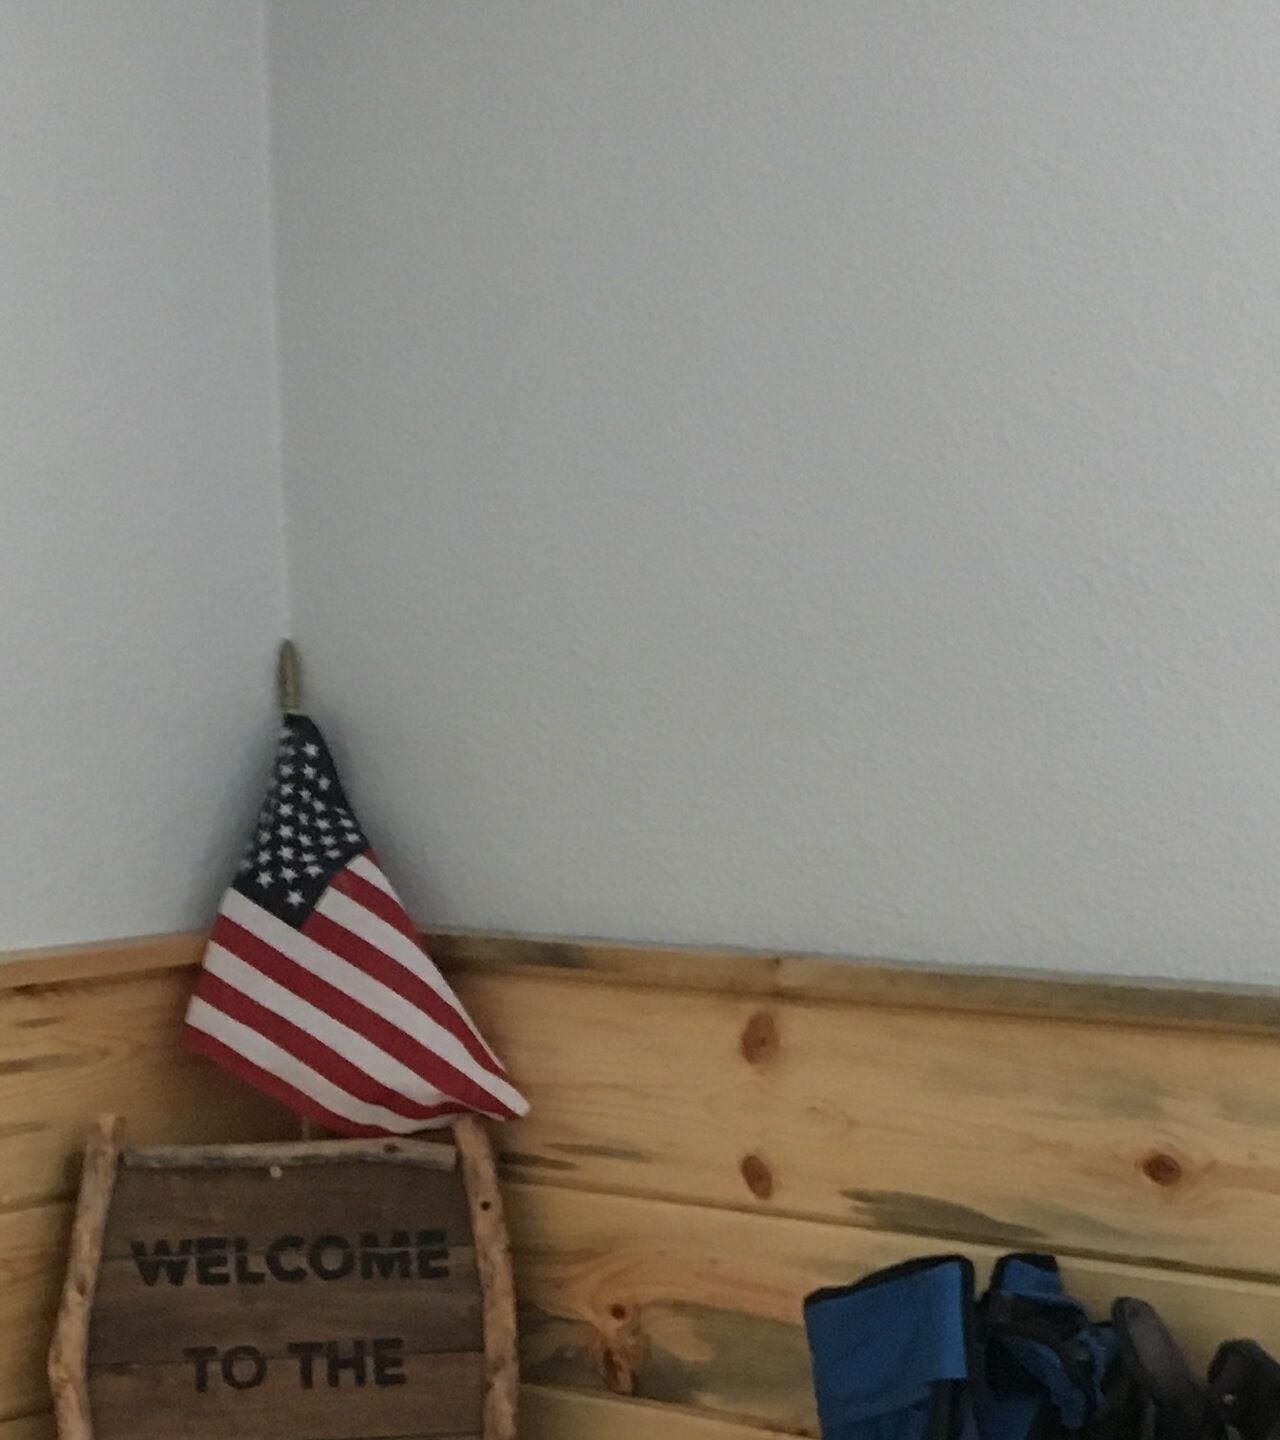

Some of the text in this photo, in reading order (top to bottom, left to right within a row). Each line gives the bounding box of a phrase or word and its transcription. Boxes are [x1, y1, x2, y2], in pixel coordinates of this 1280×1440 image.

[131, 1230, 450, 1287] WELCOME
[182, 1338, 407, 1393] TO THE
